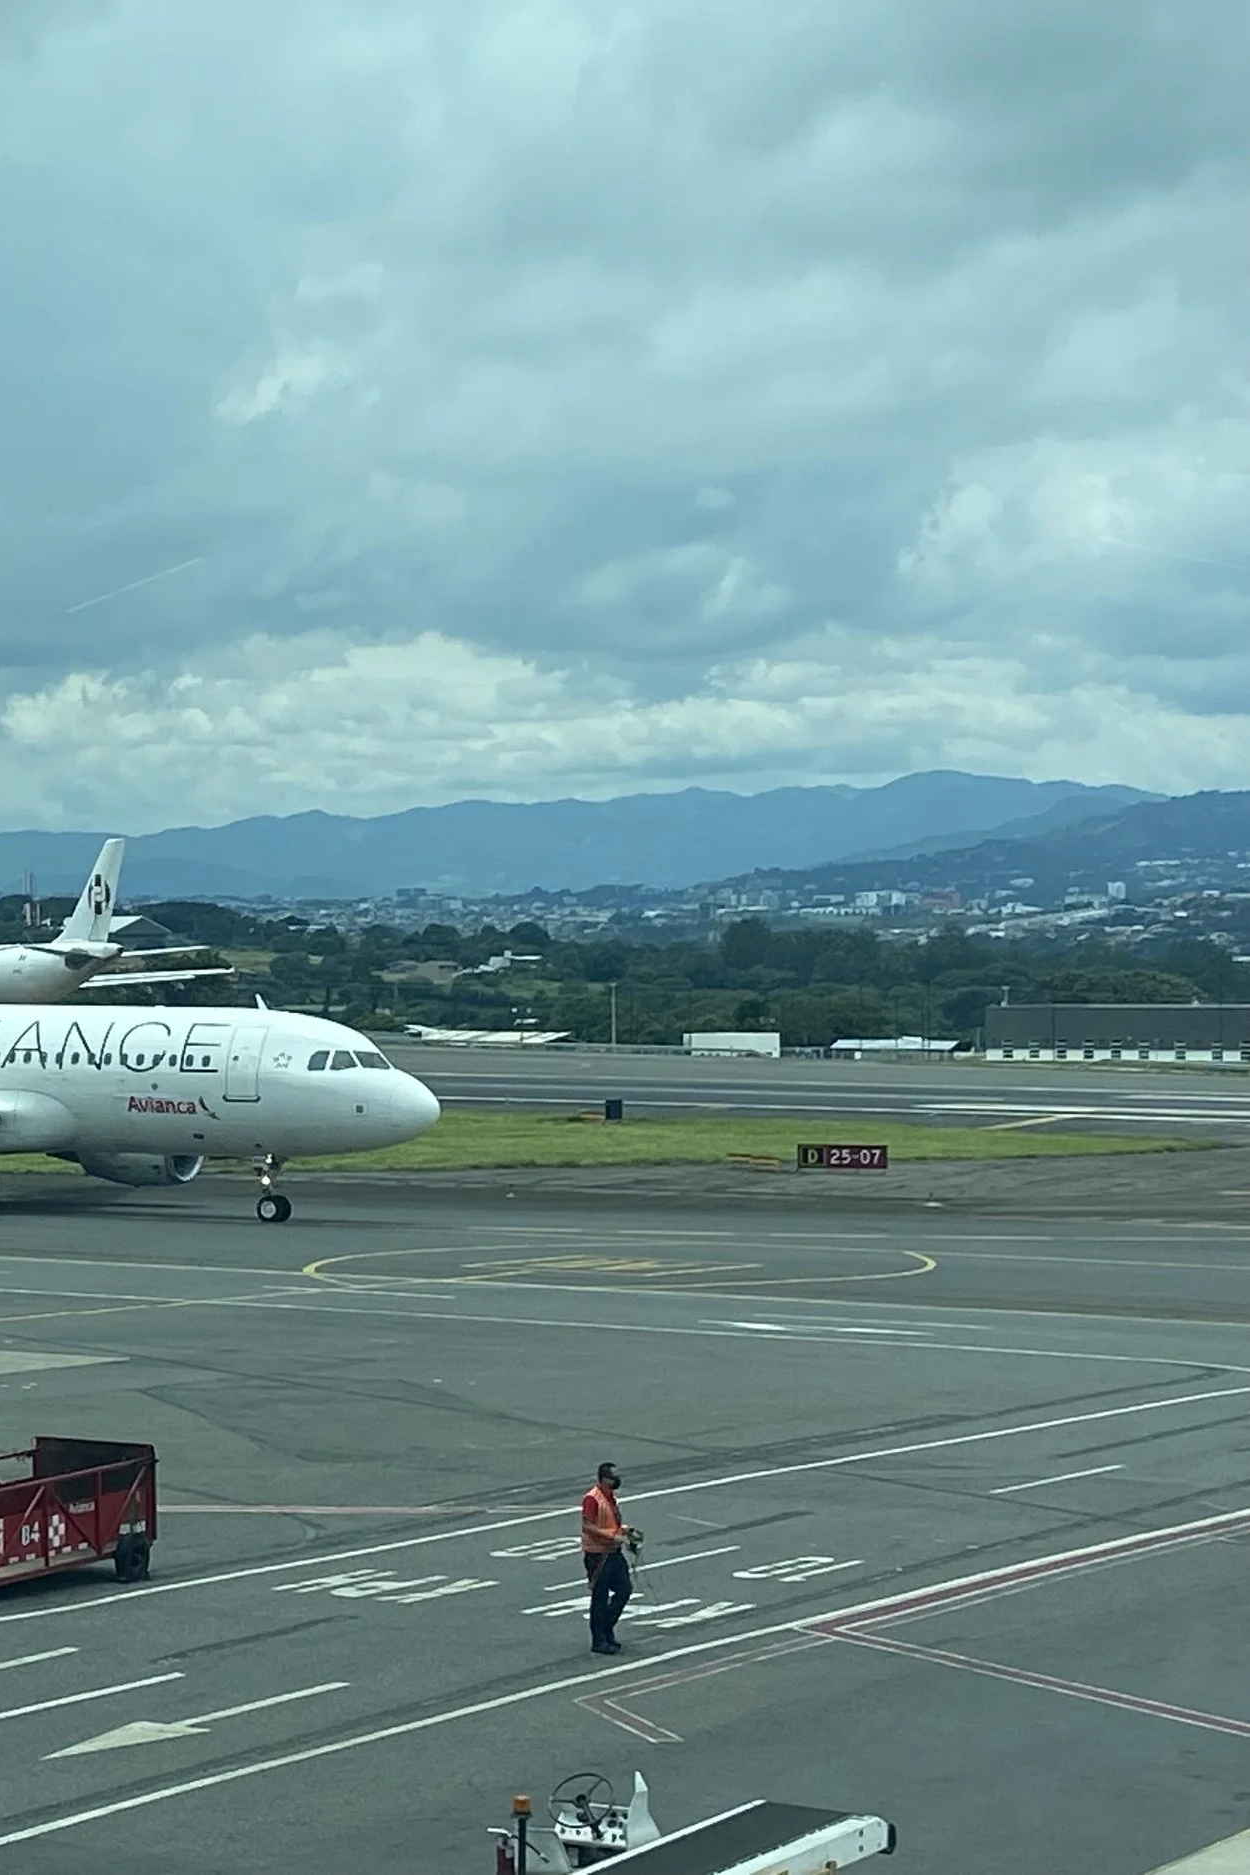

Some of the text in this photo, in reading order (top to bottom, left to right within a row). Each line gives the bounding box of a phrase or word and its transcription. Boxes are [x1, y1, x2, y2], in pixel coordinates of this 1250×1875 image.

[127, 1095, 197, 1115] Avianca
[807, 1149, 881, 1164] D 25-07
